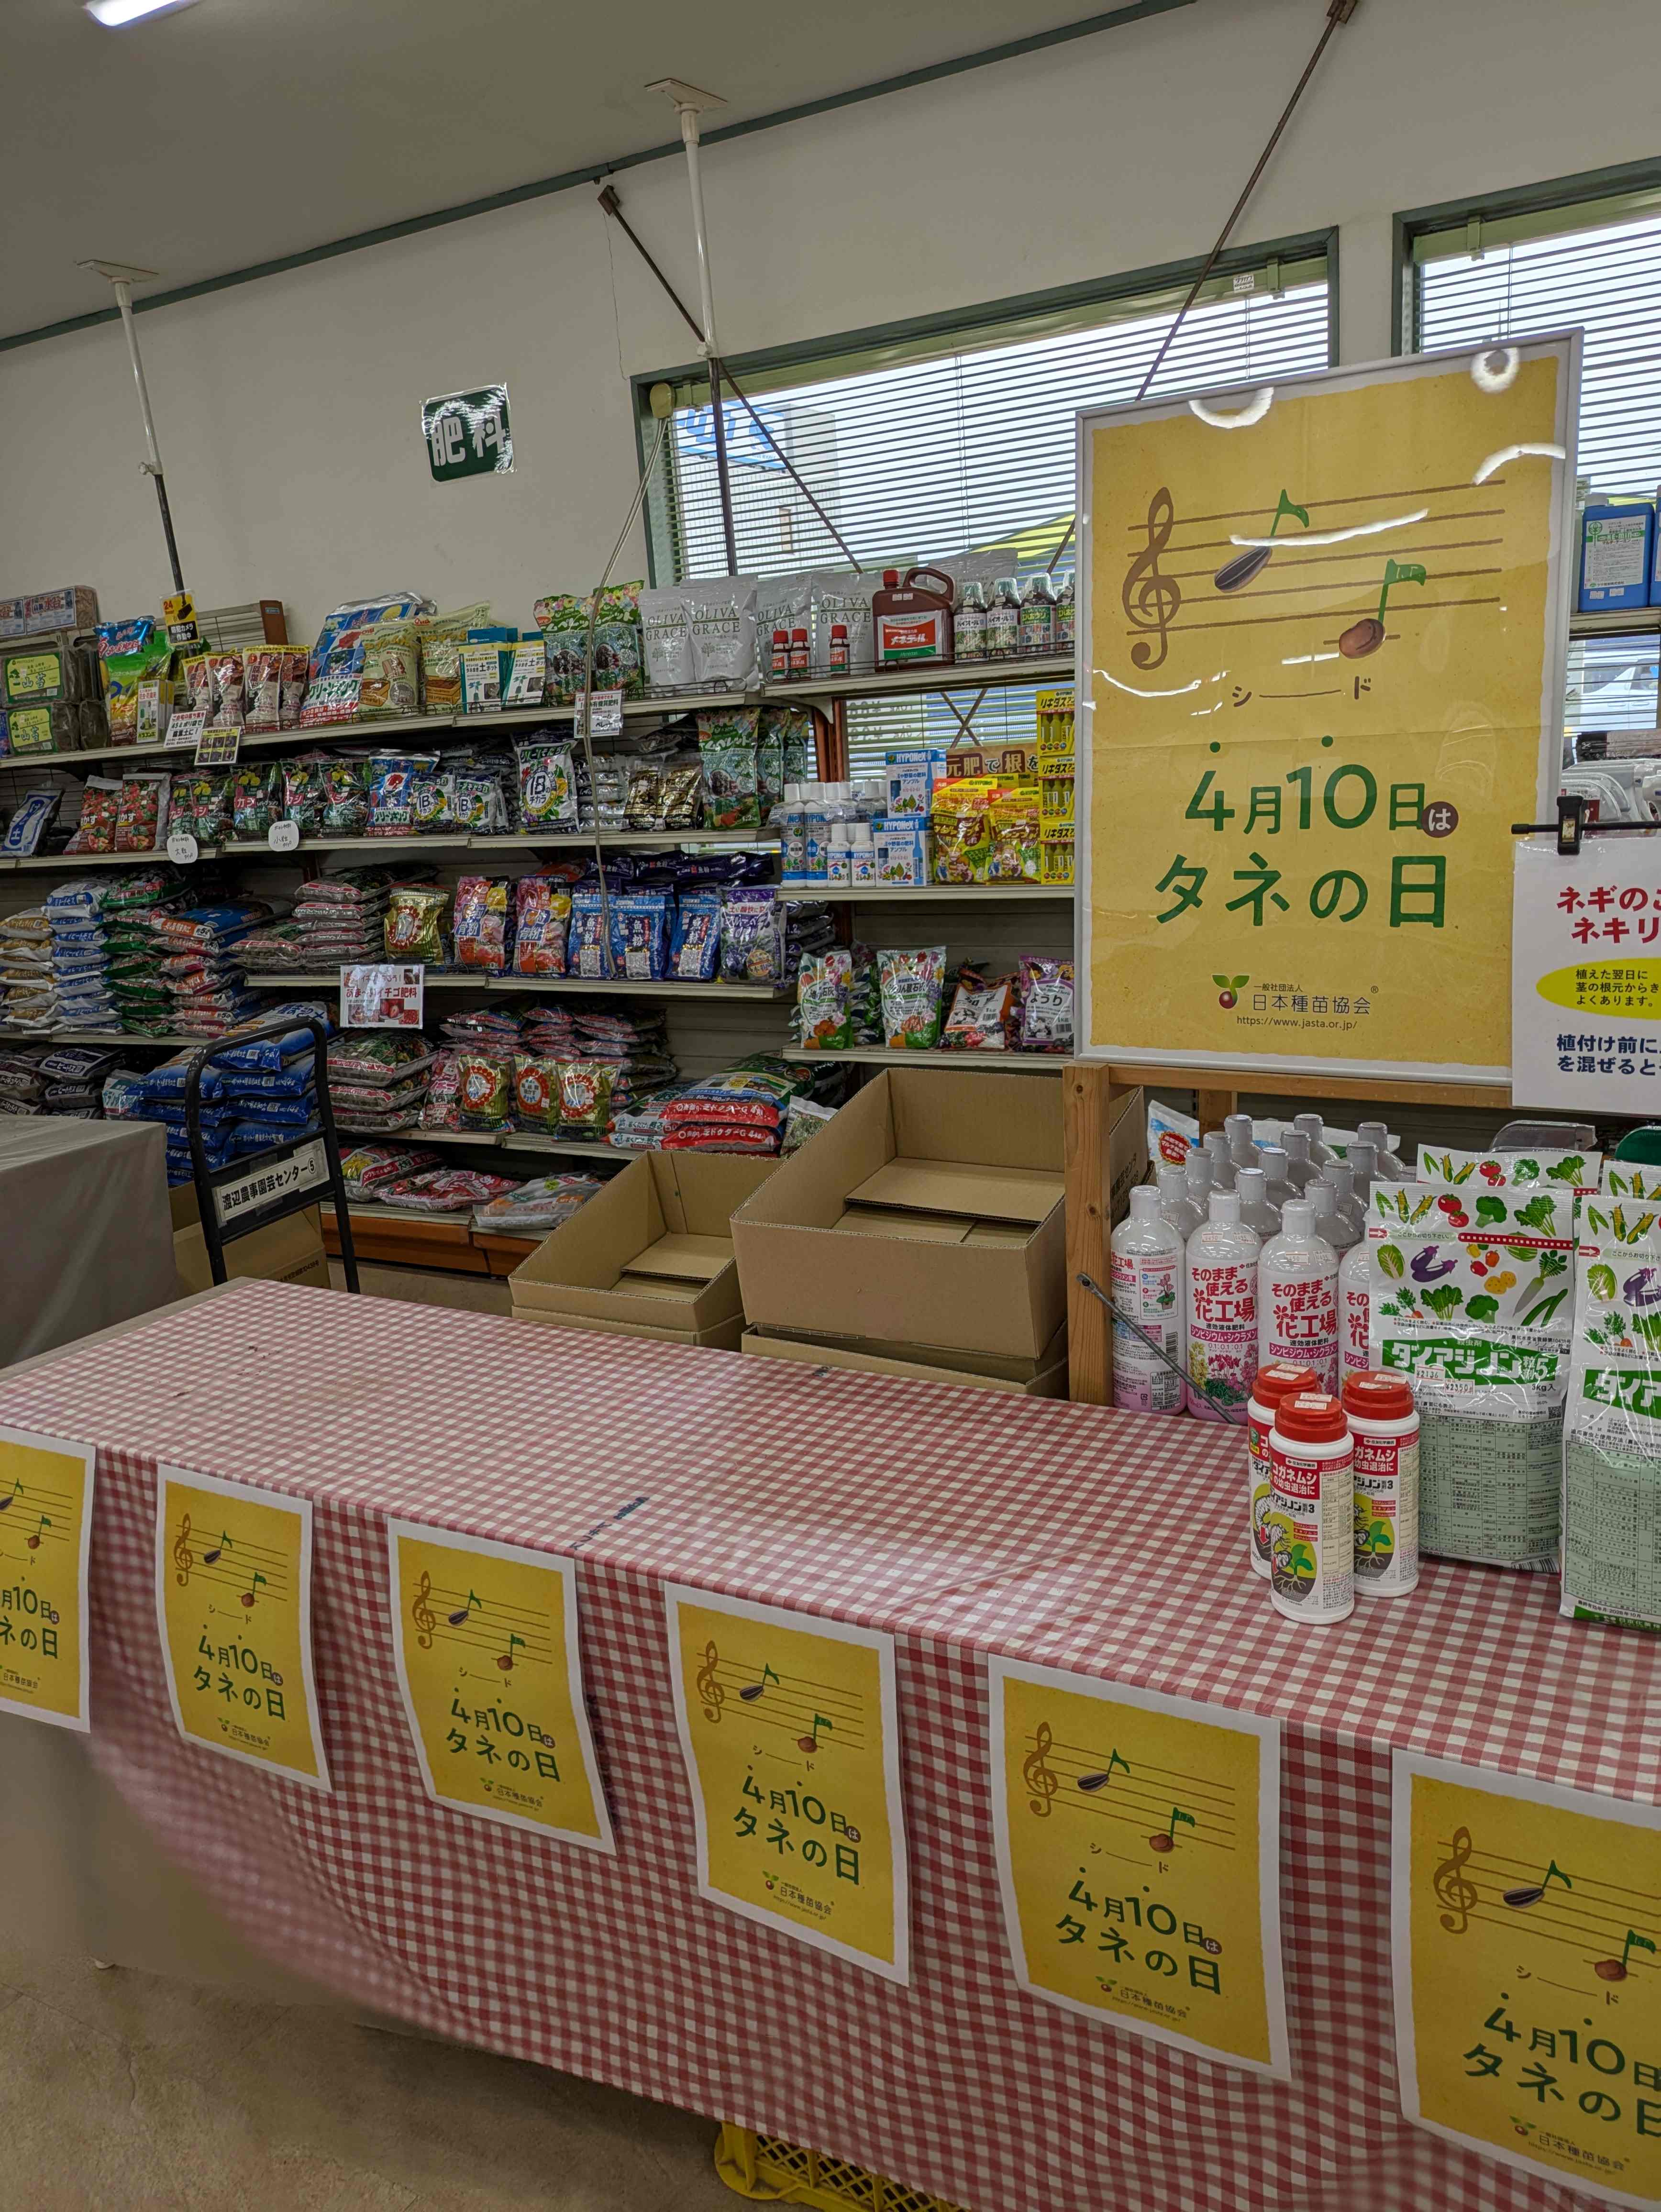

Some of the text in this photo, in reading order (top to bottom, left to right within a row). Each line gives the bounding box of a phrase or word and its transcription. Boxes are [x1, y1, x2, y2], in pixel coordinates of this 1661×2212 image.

[822, 597, 869, 609] OLIVA
[695, 608, 737, 620] OLIVA
[758, 606, 792, 622] OLIVA
[820, 611, 871, 624] GRACE
[692, 622, 740, 635] GRACE
[757, 618, 796, 636] GRACE
[884, 820, 913, 830] HYPONeX
[1155, 852, 1447, 928] タネの日
[1557, 885, 1661, 915] ネギの
[632, 920, 643, 947] 魚粉
[1571, 916, 1660, 944] ネキリ
[1575, 969, 1649, 981] 植えた翌日に
[1253, 983, 1303, 993] 一般社団法人
[1575, 982, 1660, 994] 茎の根元からき
[1252, 993, 1371, 1016] 日本種苗協会
[1576, 995, 1654, 1007] よくあります。
[1236, 1015, 1358, 1031] https://www.jasta.or.jp/
[1556, 1033, 1661, 1054] 植付け前に
[1557, 1055, 1661, 1076] を混ぜると
[1191, 1267, 1238, 1282] そのまま
[1206, 1278, 1249, 1297] 使える
[1271, 1279, 1323, 1298] そのまま
[1194, 1292, 1255, 1323] 花工場
[1289, 1290, 1332, 1313] 使える
[1346, 1292, 1369, 1306] その
[1273, 1307, 1338, 1339] 花工場
[1392, 1342, 1520, 1379] ダイアジノン
[1354, 1446, 1396, 1463] ガネムシ
[1273, 1463, 1317, 1485] コガネムシ
[1354, 1459, 1394, 1472] 幼虫退治に
[1273, 1475, 1316, 1495] の幼虫退治に
[0, 1617, 58, 1660] ネの日
[194, 1666, 287, 1721] タネの日
[447, 1728, 561, 1782] タネの日
[733, 1807, 860, 1886] タネの日
[1056, 1914, 1221, 1996] タネの日
[1463, 2043, 1661, 2137] タネの日
